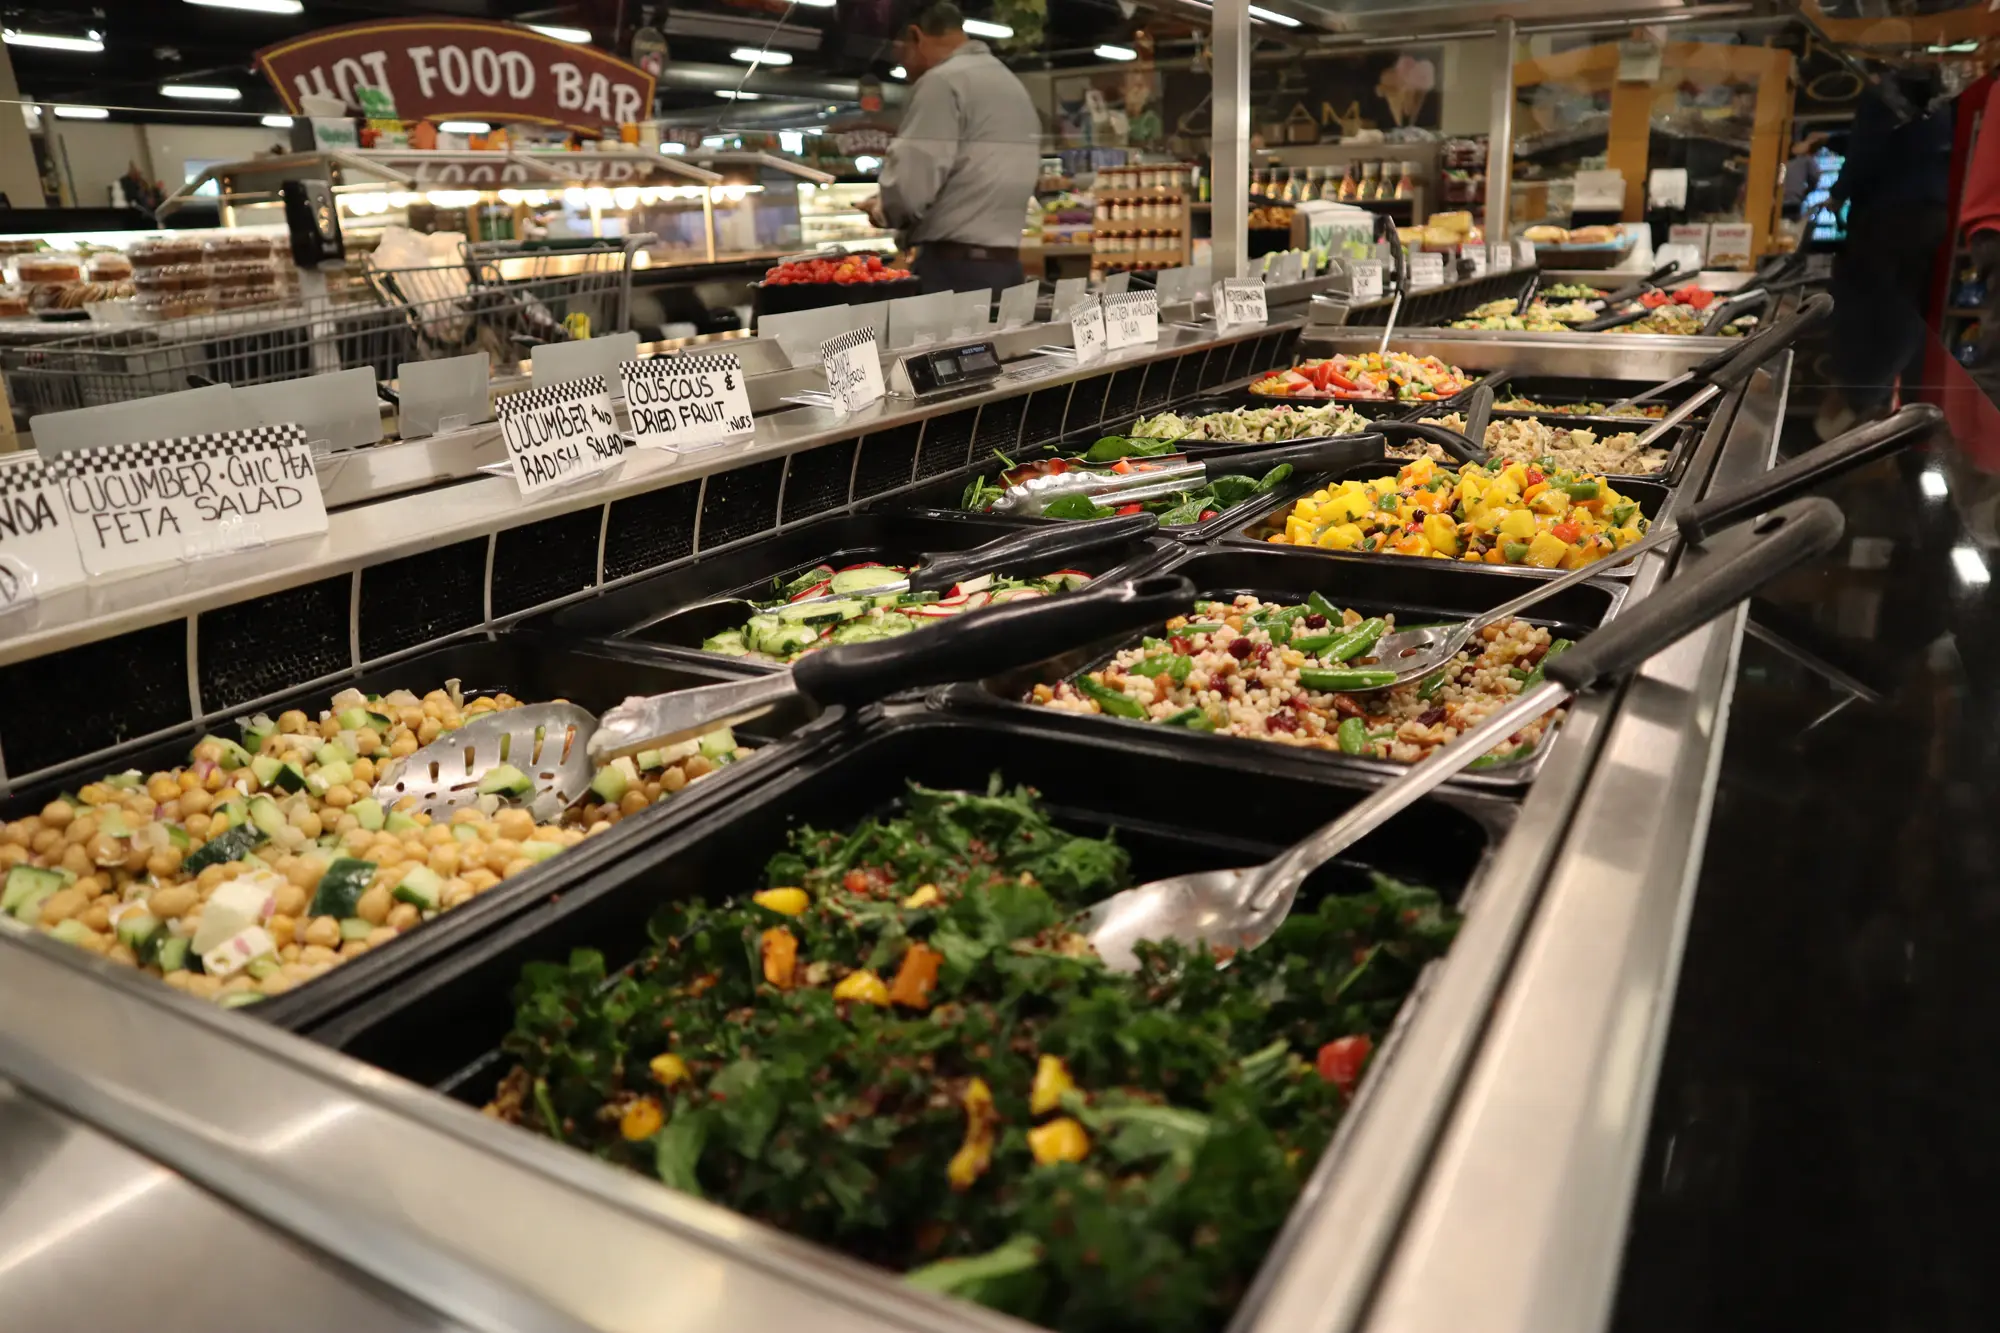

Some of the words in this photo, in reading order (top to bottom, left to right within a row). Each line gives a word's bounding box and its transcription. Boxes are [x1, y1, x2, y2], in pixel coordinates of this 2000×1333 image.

[293, 50, 396, 110] HOT
[407, 45, 535, 99] FOOD
[550, 62, 642, 123] BAR
[627, 374, 714, 406] COUSCOUS
[631, 407, 677, 435] DRIED
[679, 400, 725, 428] FRUIT
[503, 404, 594, 453] CUCUMBER
[591, 403, 612, 426] AND
[66, 461, 218, 514] CUCUMBER
[227, 454, 277, 488] CHIC
[276, 443, 314, 479] PEA
[519, 443, 585, 487] RADISH
[586, 432, 624, 461] SALAD
[91, 505, 182, 549] FETA
[194, 486, 303, 521] SALAD
